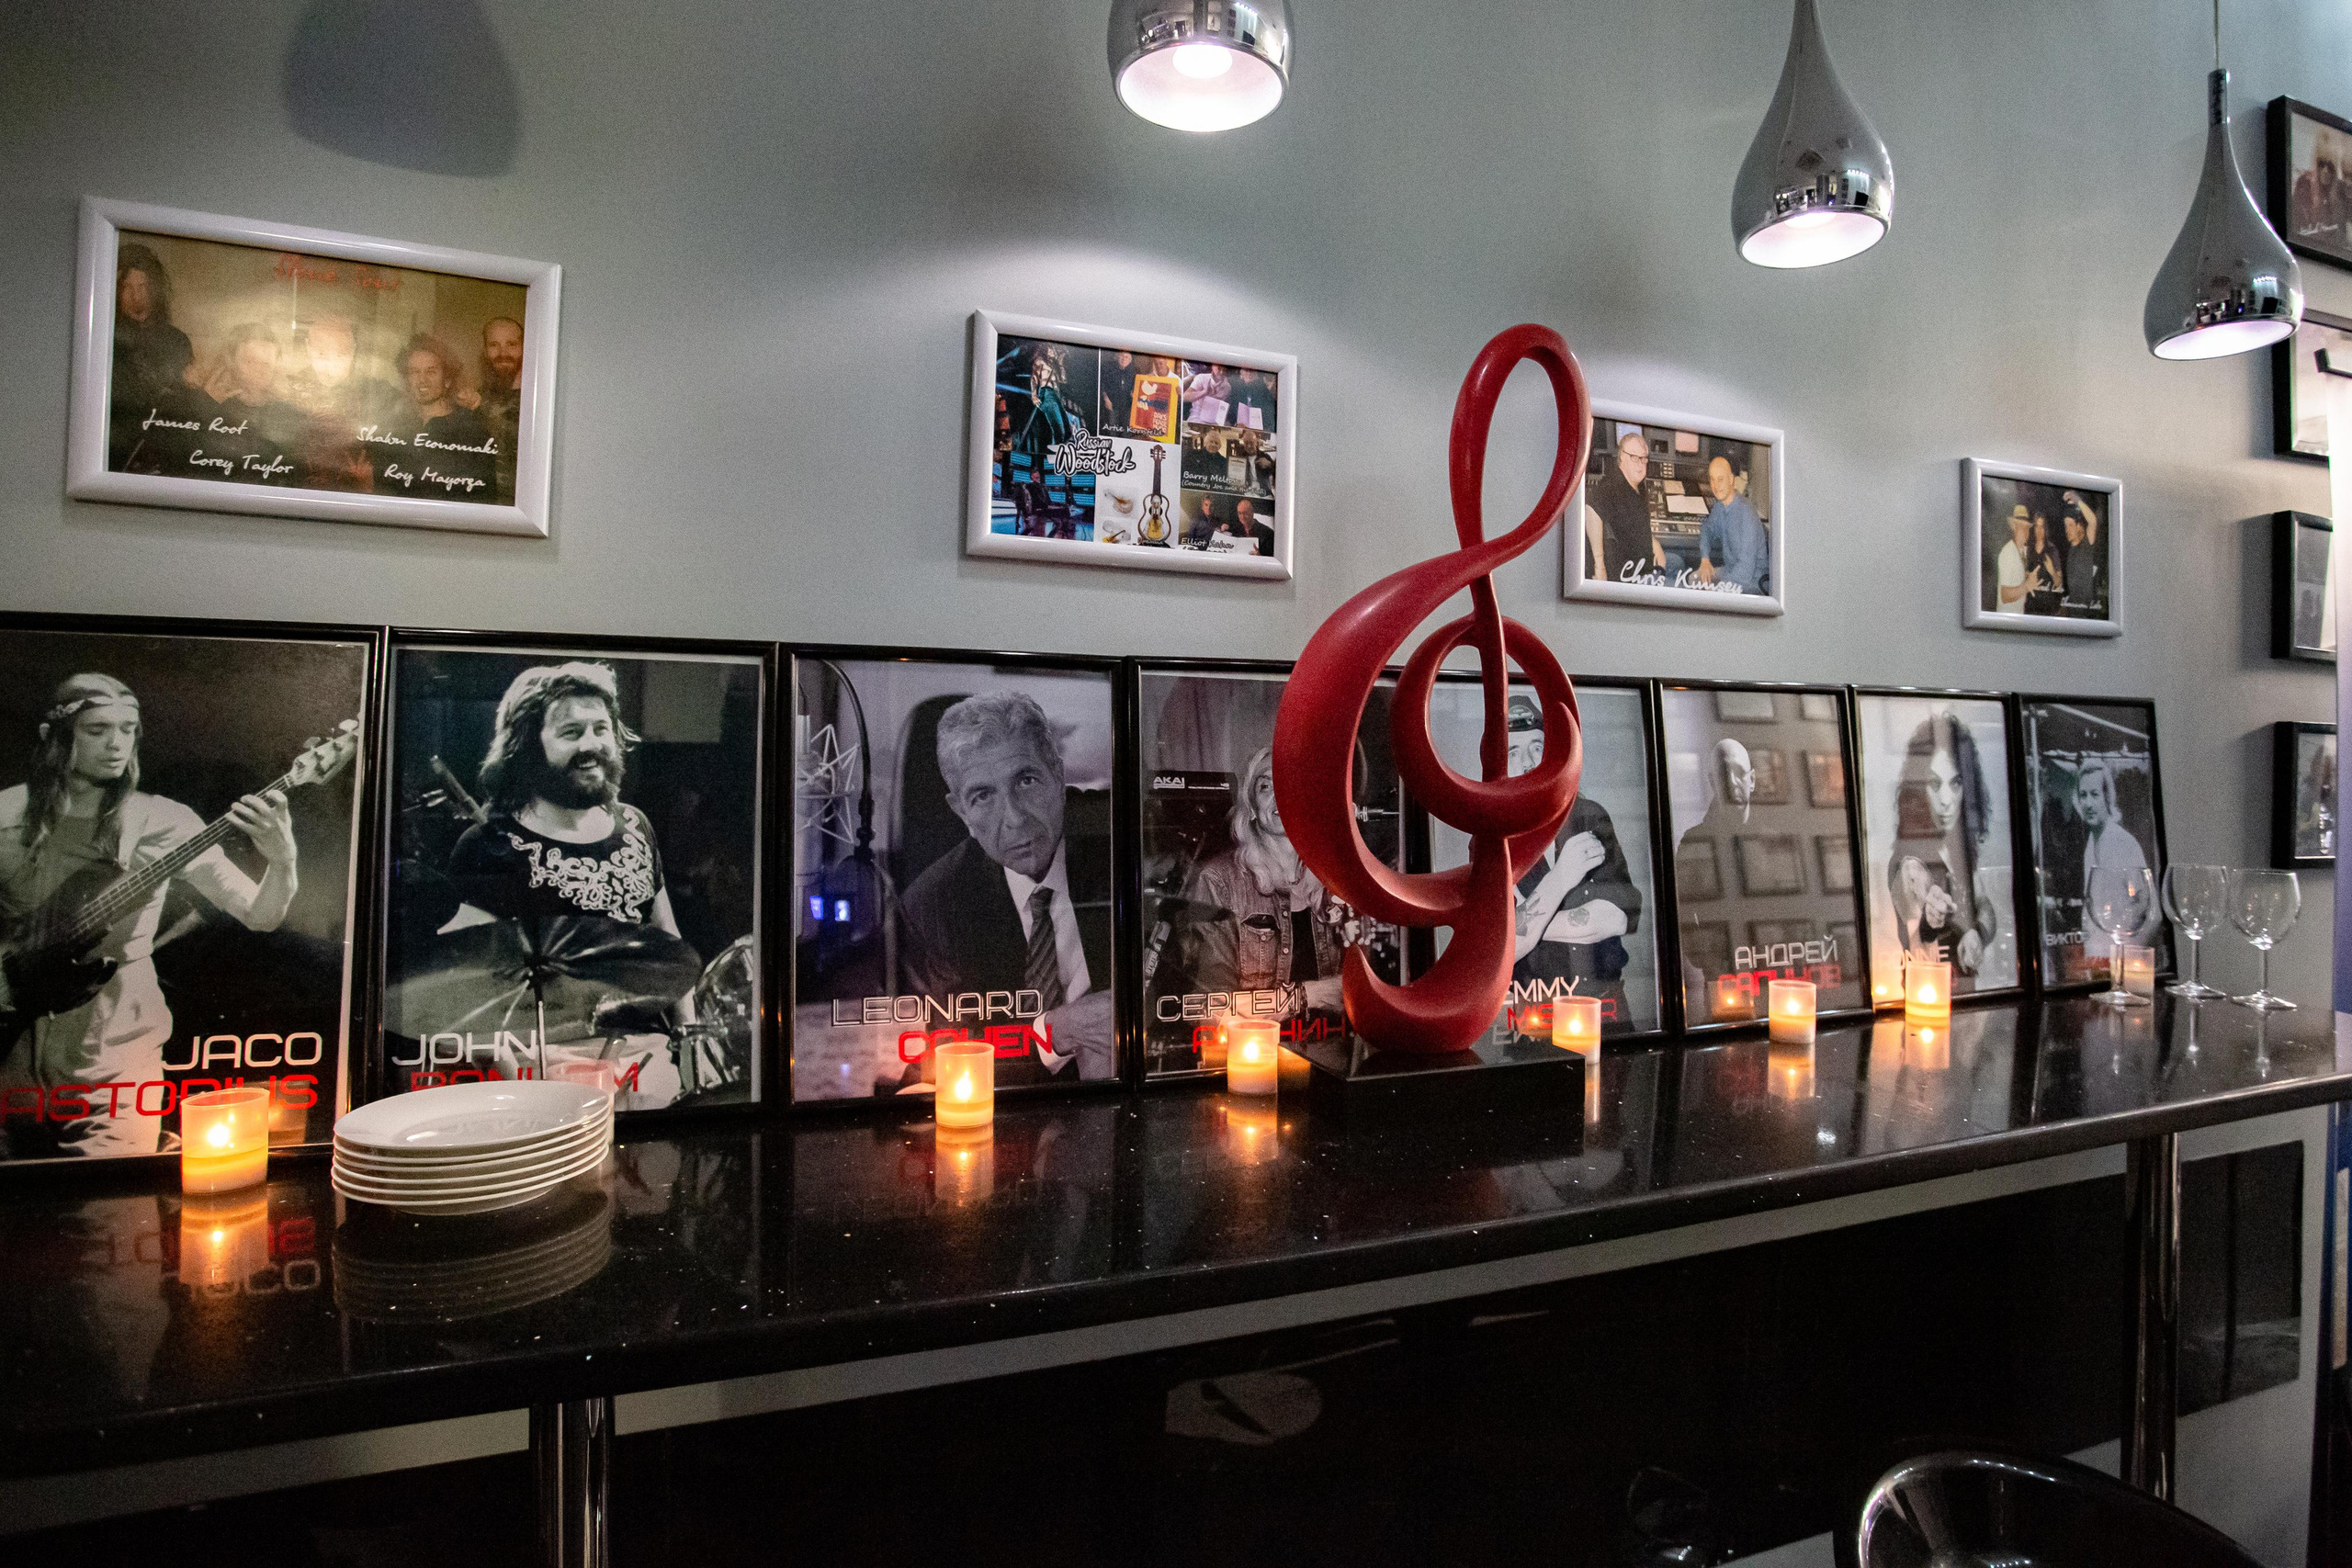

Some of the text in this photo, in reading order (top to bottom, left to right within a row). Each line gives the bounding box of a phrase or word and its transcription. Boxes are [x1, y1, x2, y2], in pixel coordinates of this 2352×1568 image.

[141, 408, 249, 435] James Root
[1102, 423, 1125, 432] Artie
[1075, 428, 1113, 450] Russian
[188, 449, 295, 479] Corey Taylor
[1054, 443, 1136, 477] Woodstock
[384, 463, 414, 488] Roy
[1182, 470, 1208, 482] Barry
[1181, 536, 1207, 547] Elliot
[1619, 558, 1666, 588] Chris
[1153, 776, 1185, 786] AKAI
[1734, 933, 1838, 971] АНДРЕЙ
[831, 988, 1044, 1028] LEONARD
[1156, 982, 1302, 1022] СЕРГЕЙ
[161, 1032, 323, 1071] JACO
[391, 1029, 537, 1066] JOHN
